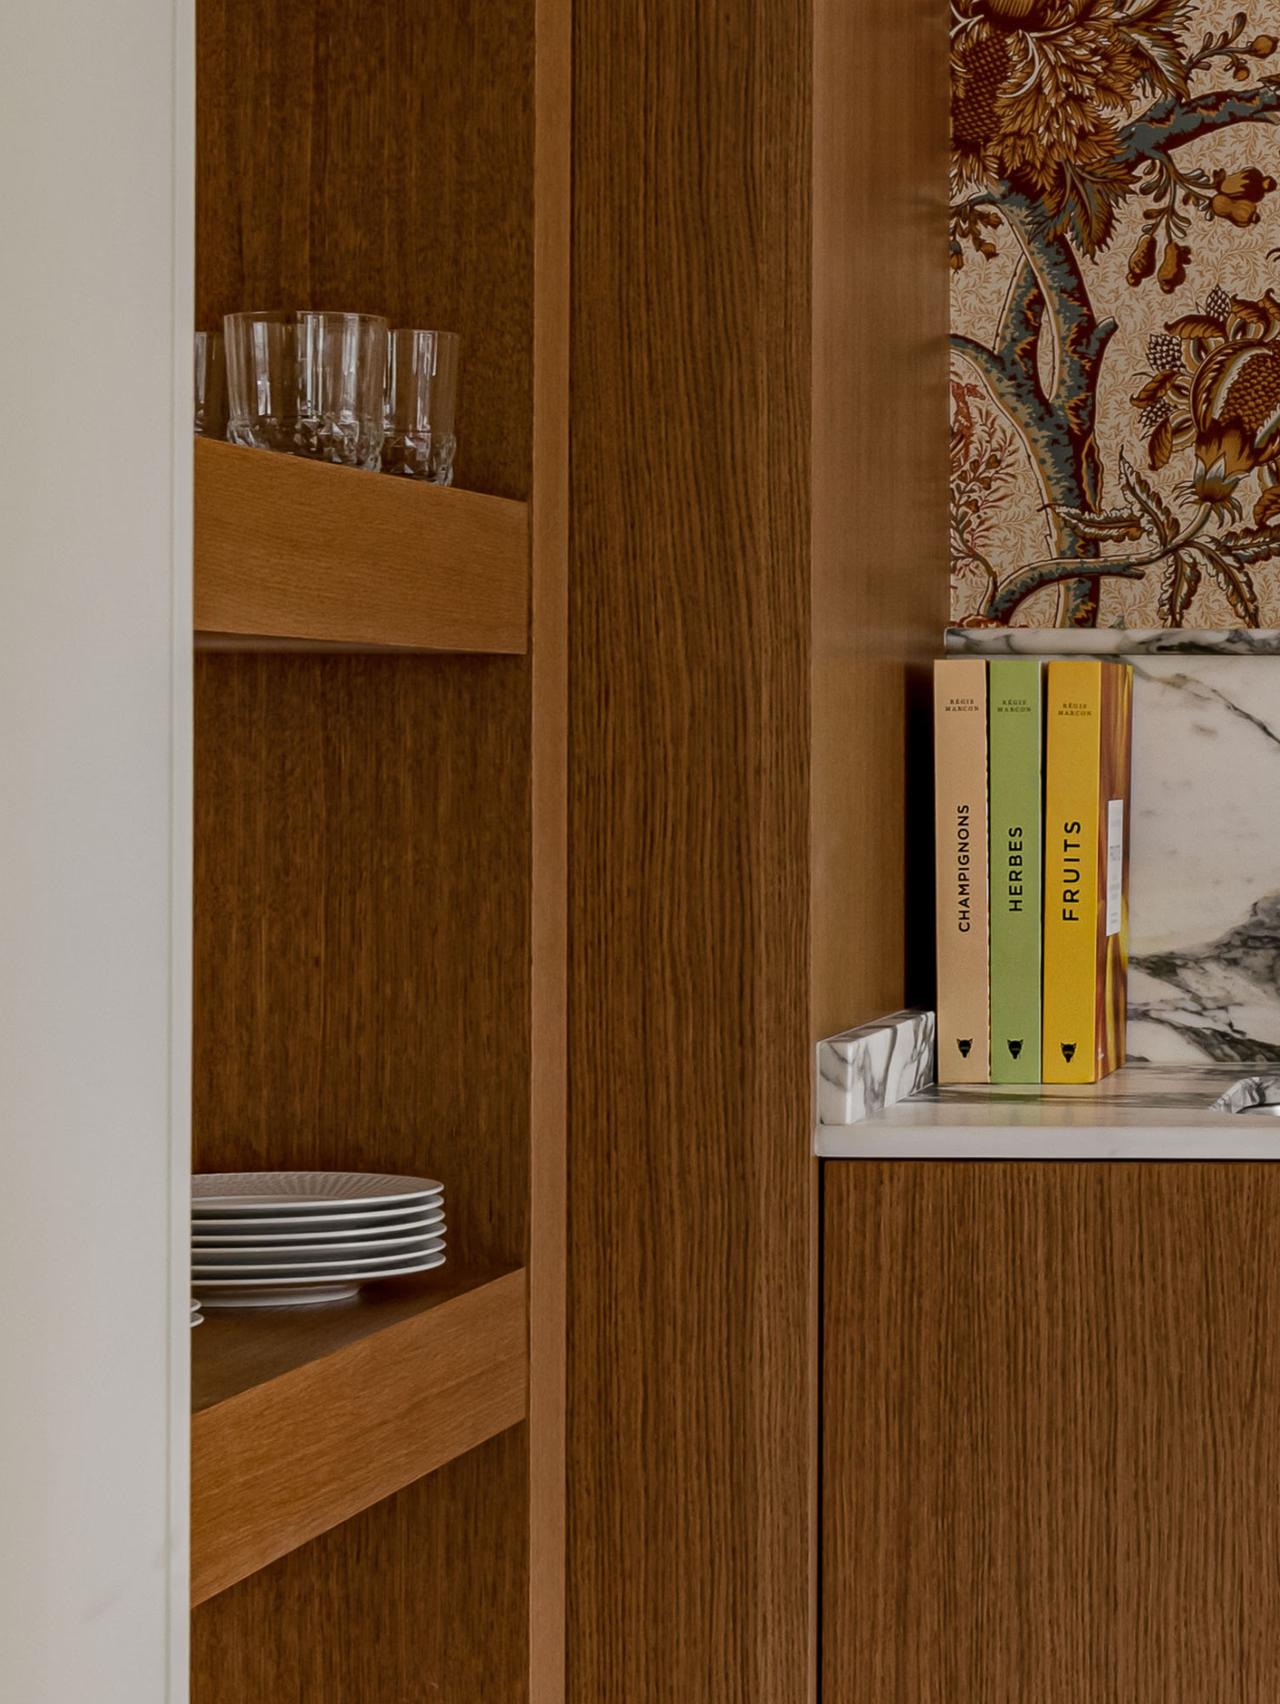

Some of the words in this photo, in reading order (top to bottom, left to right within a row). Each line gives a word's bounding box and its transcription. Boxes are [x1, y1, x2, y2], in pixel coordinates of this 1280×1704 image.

[957, 804, 970, 932] CHAMPIGNONS
[1009, 826, 1022, 912] HERBES
[1062, 821, 1081, 921] FRUITS
